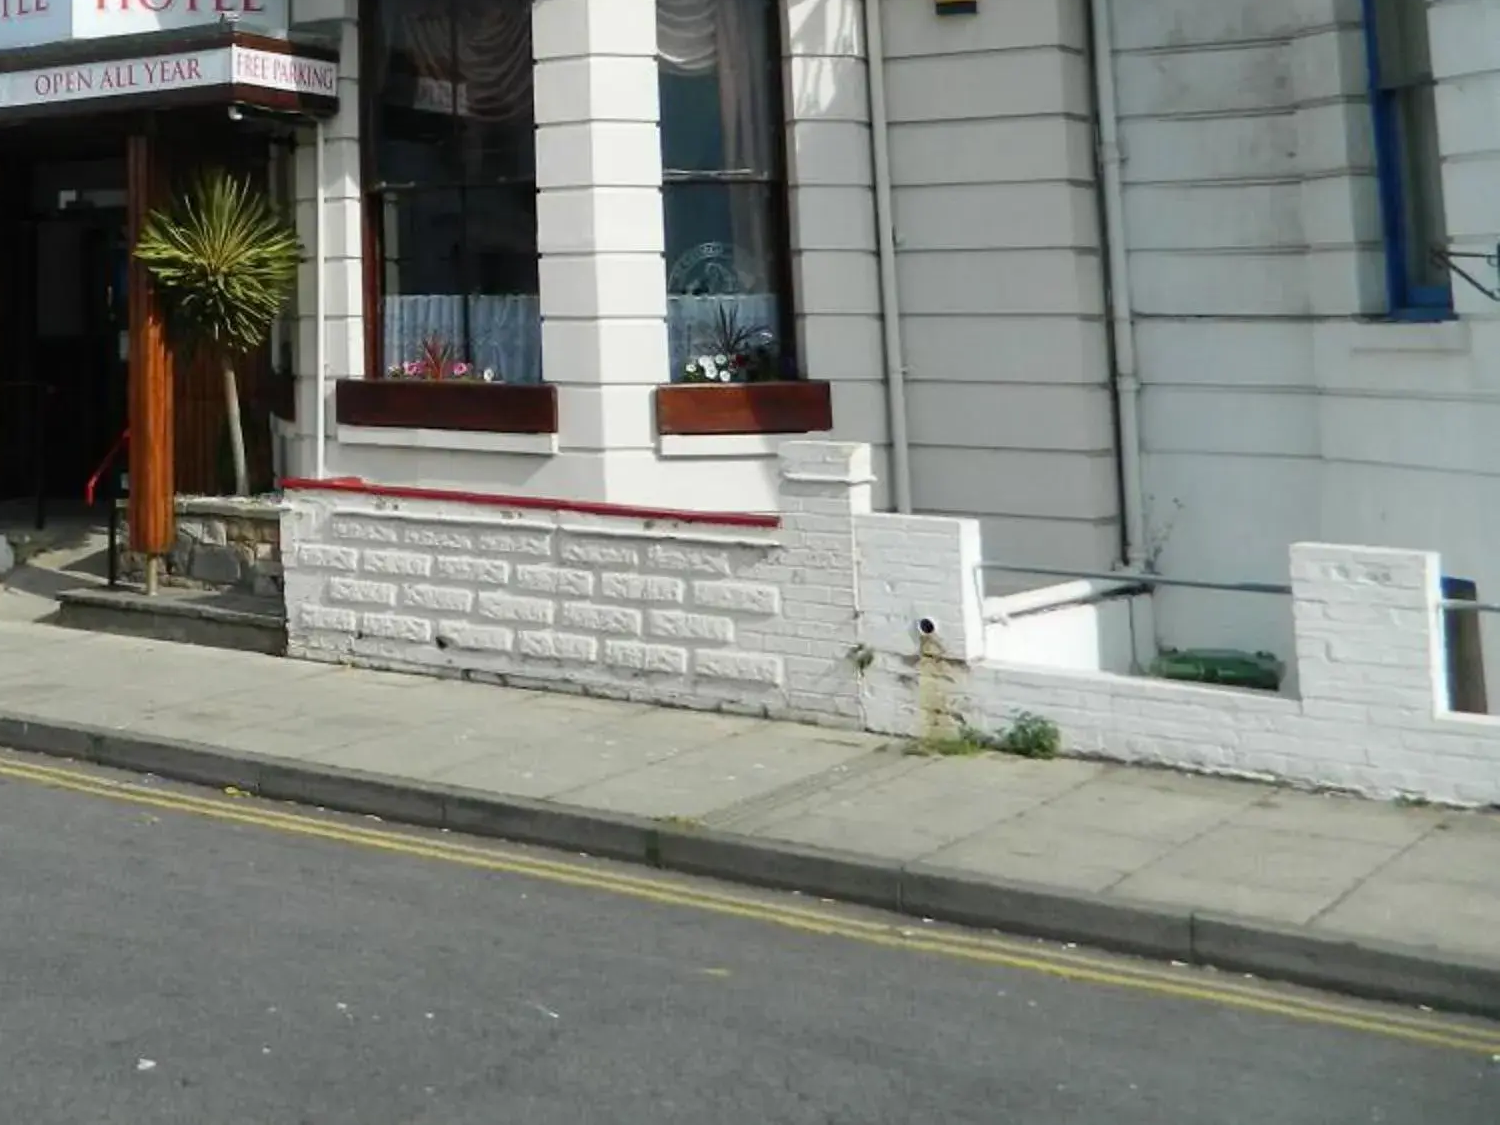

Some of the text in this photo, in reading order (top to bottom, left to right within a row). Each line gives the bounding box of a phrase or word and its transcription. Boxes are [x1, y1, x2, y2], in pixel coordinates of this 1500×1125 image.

[35, 73, 92, 96] OPEN
[99, 65, 138, 88] ALL
[143, 57, 203, 83] YEAR
[236, 52, 335, 90] FREE PARKING
